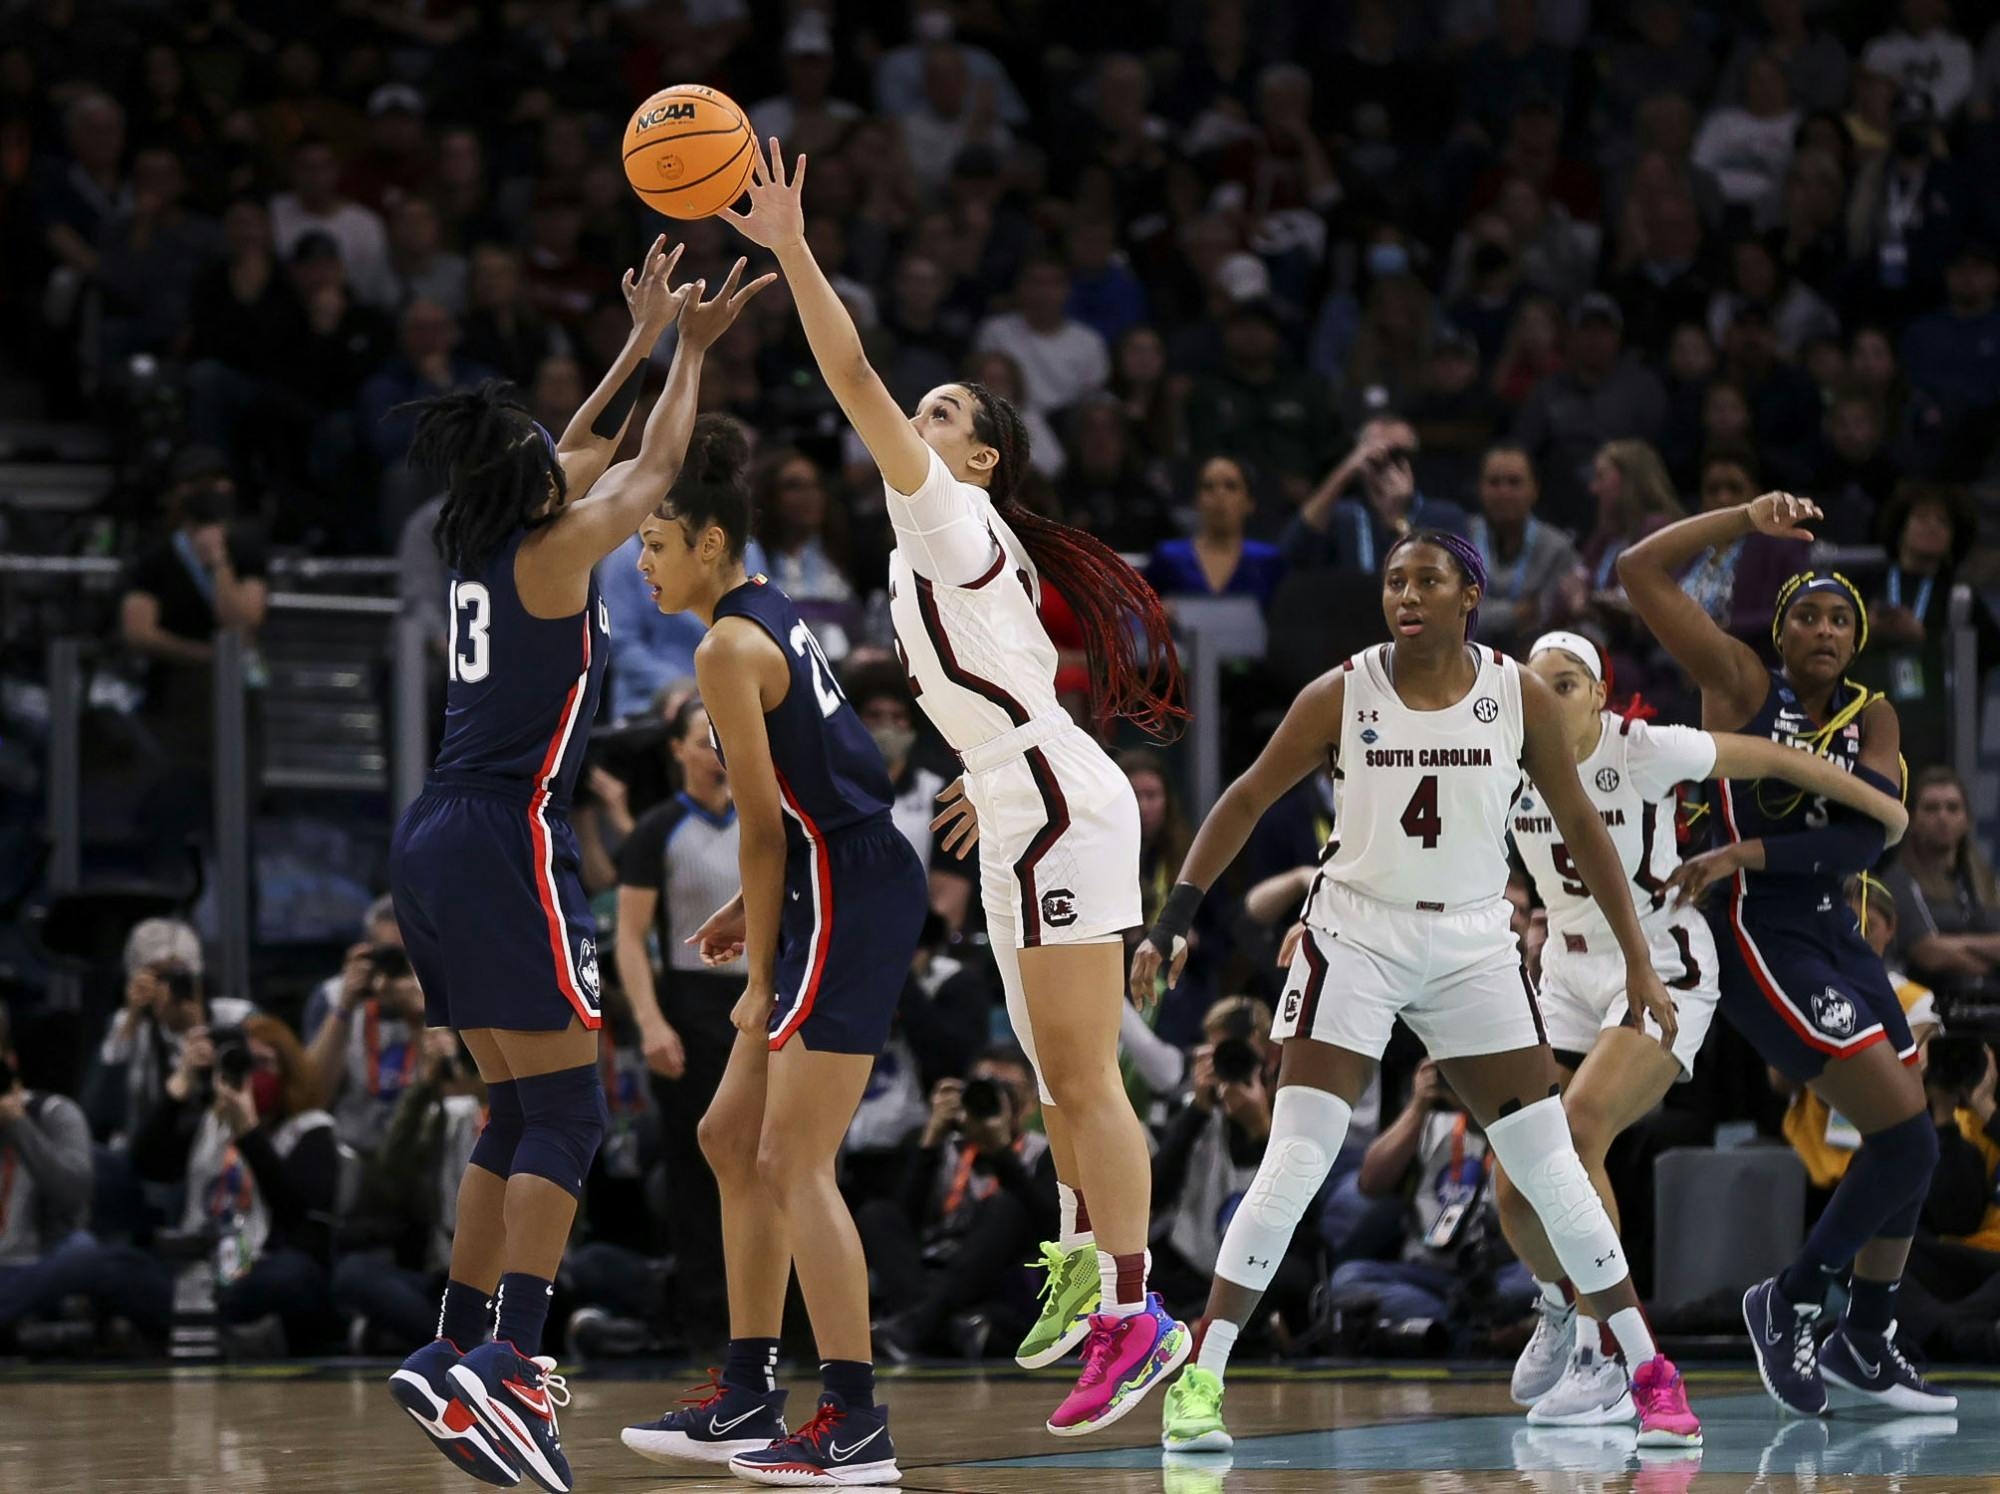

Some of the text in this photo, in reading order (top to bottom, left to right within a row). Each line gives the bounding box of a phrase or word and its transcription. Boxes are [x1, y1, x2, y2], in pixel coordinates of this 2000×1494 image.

[636, 103, 696, 134] NCAA
[449, 580, 491, 684] 13
[1475, 701, 1498, 722] SEC
[1365, 749, 1492, 768] SOUTH CAROLINA
[1596, 769, 1619, 791] SEC
[1400, 775, 1442, 849] 4
[1514, 816, 1552, 834] SOUTH
